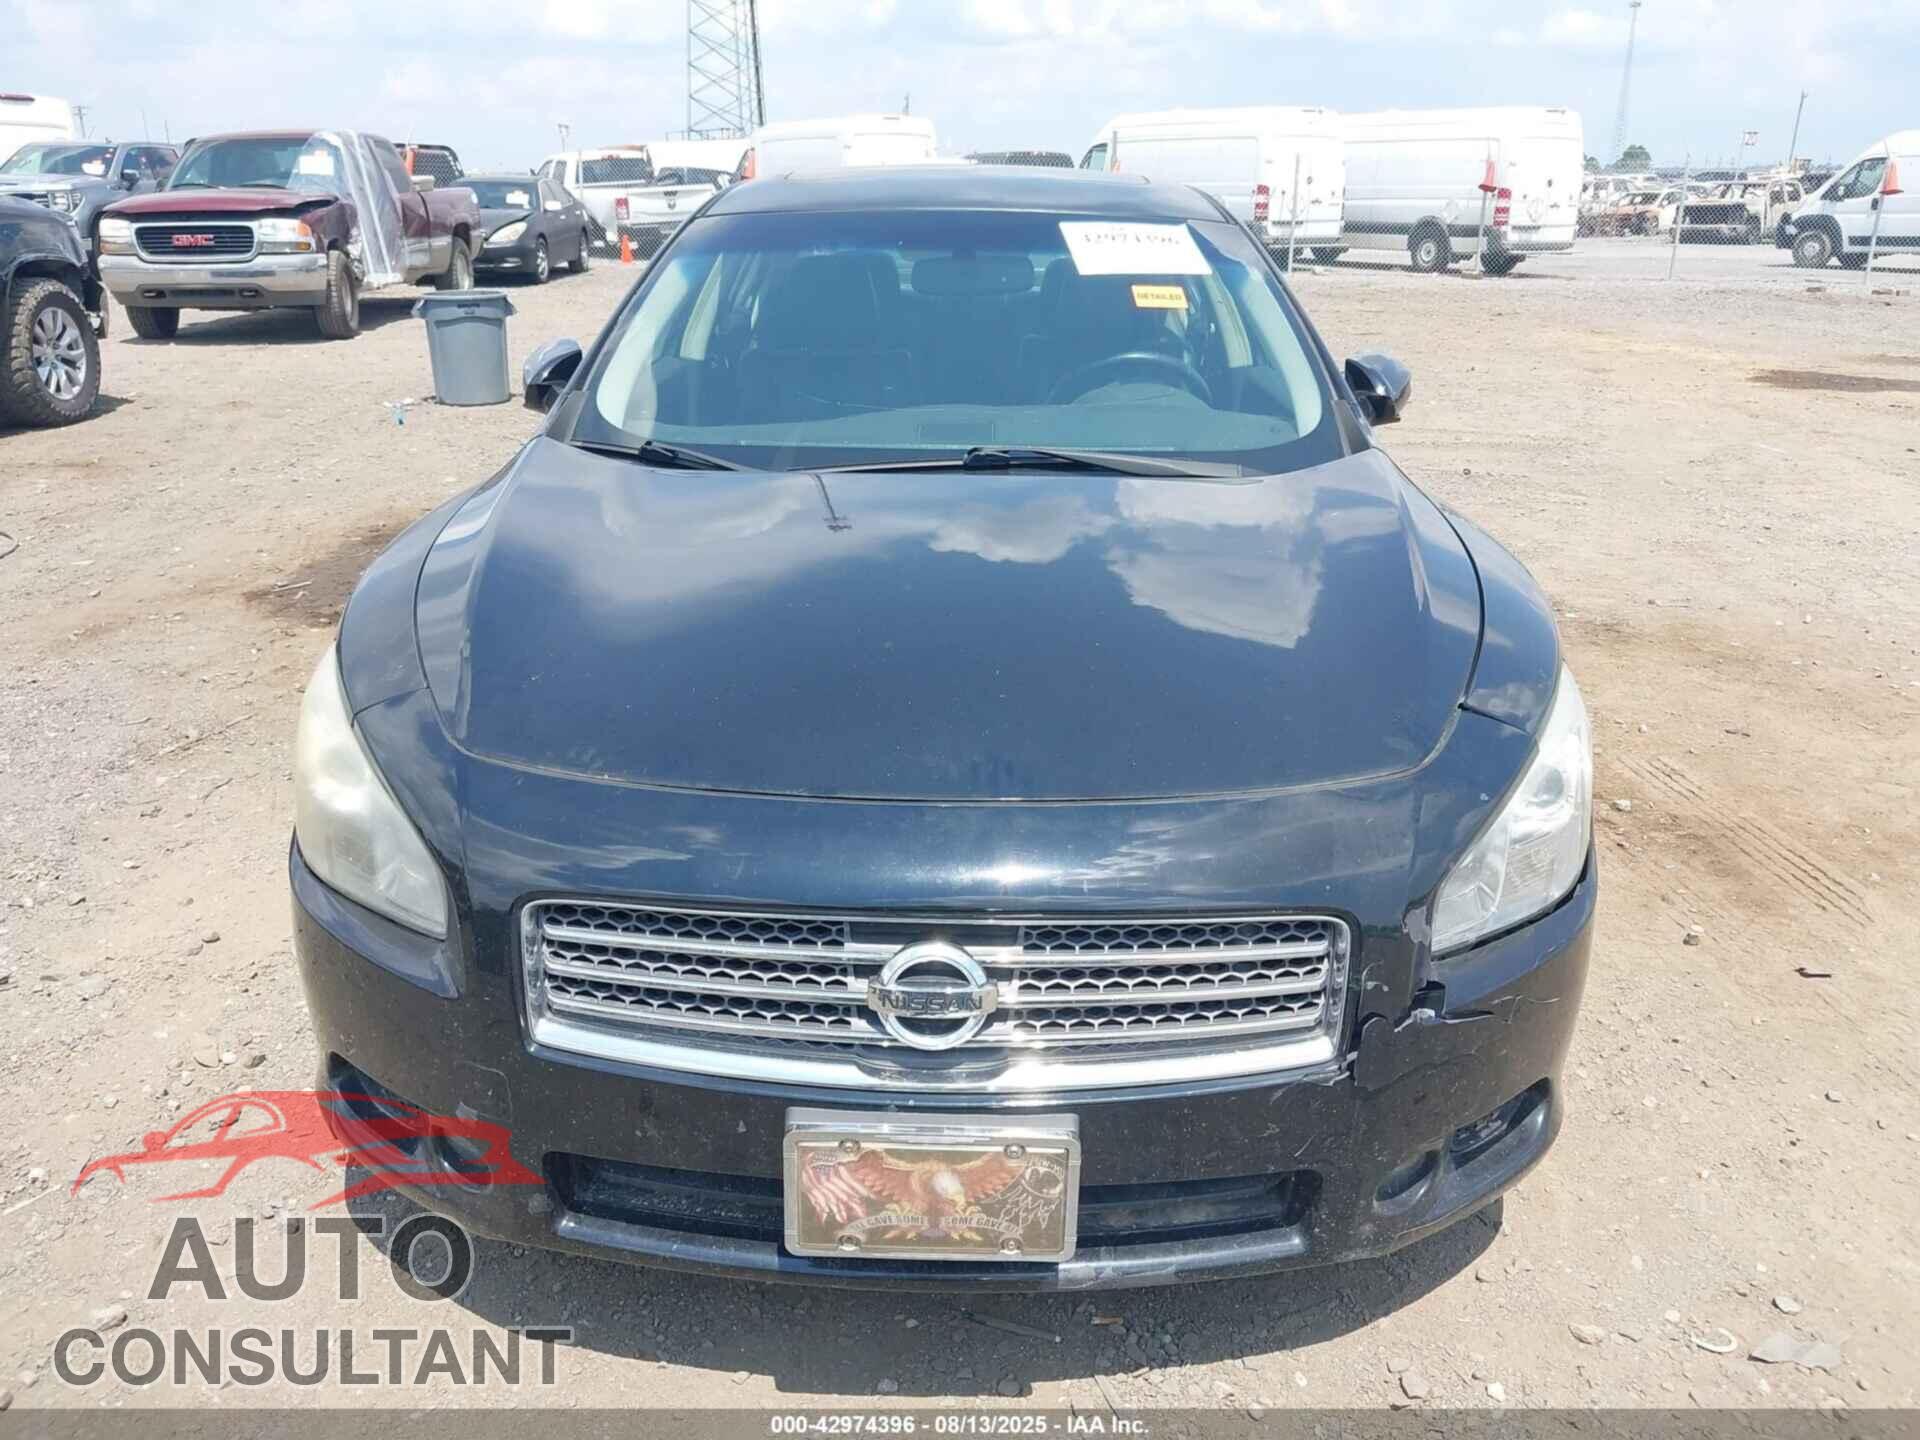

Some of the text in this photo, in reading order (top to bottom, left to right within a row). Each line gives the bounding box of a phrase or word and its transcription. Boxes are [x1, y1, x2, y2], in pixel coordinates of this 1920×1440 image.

[171, 234, 214, 246] GMC
[1136, 293, 1182, 301] DETAILED
[881, 993, 983, 1011] NISSAN
